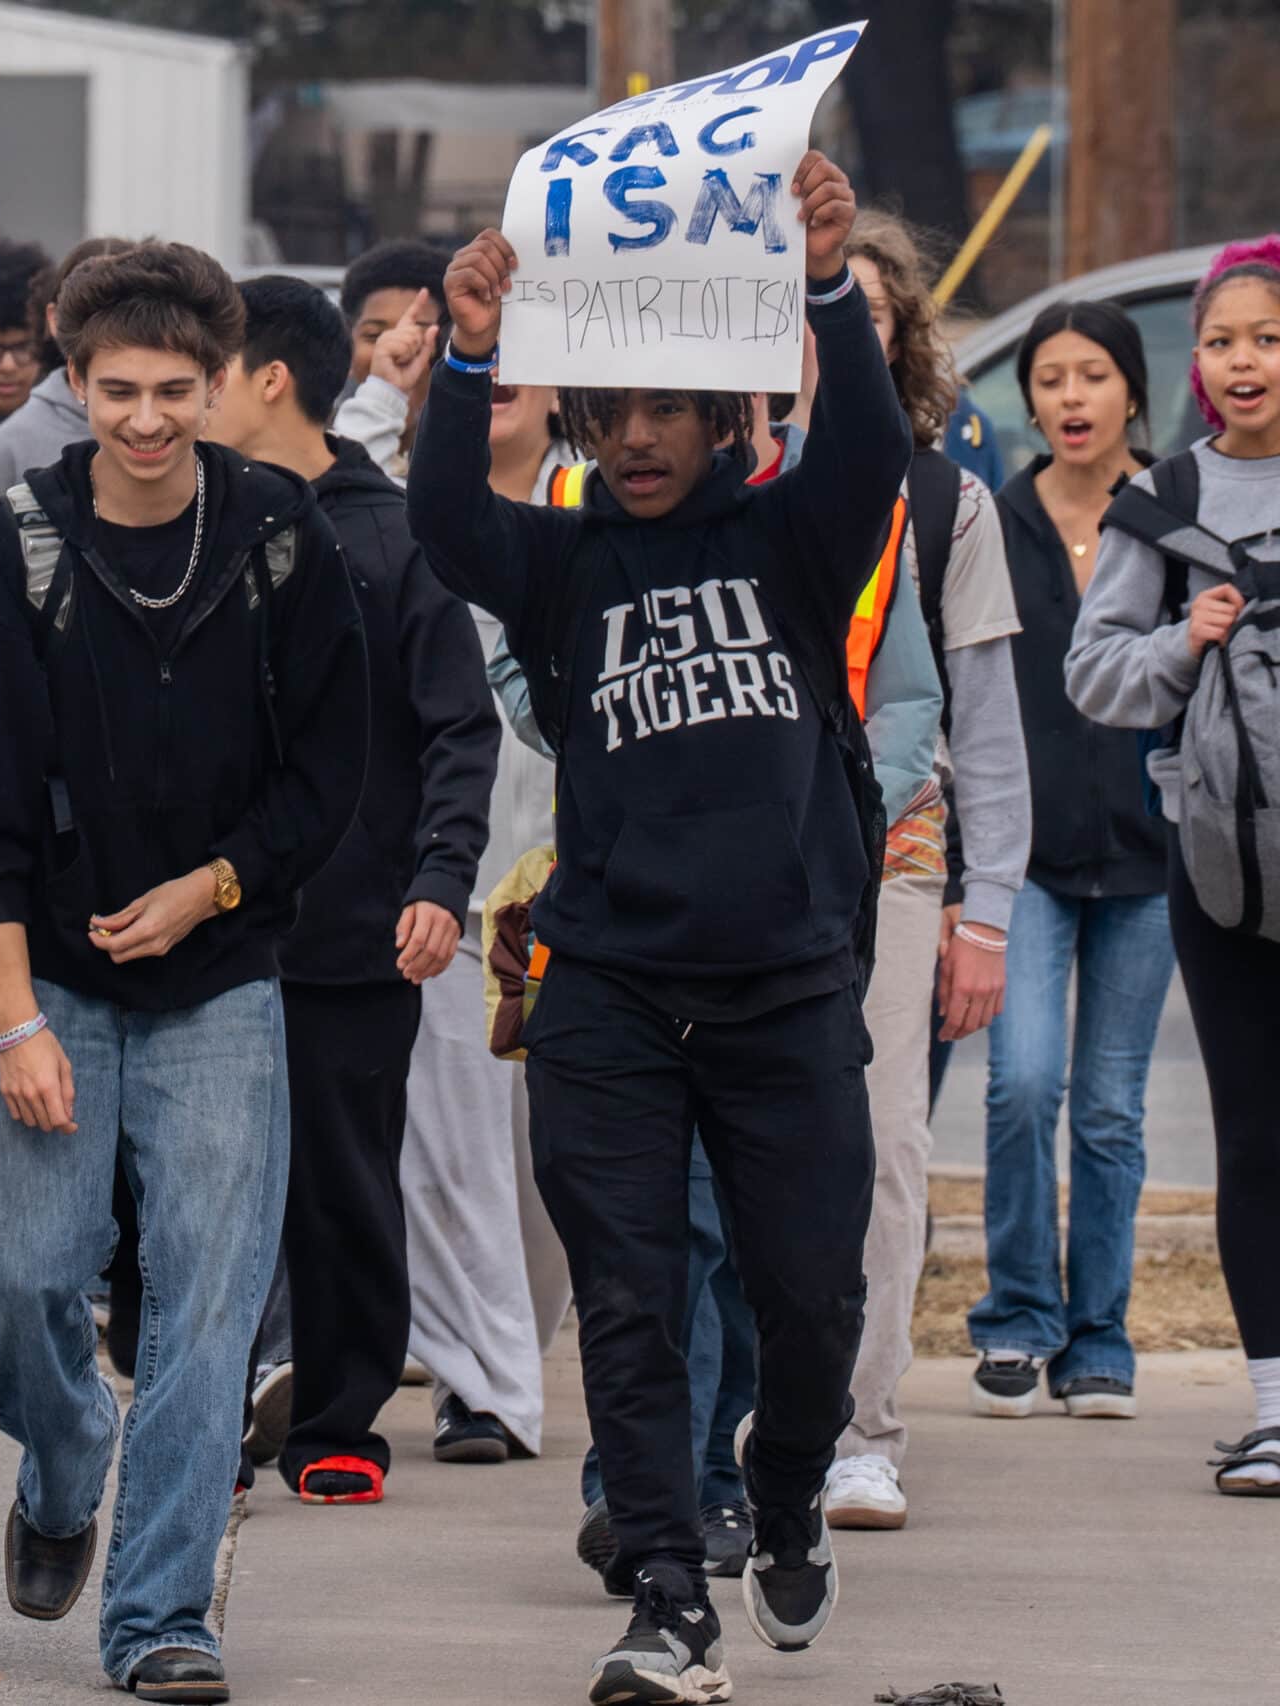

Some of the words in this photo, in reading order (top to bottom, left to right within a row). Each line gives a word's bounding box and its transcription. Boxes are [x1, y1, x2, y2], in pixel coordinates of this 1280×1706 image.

[599, 29, 861, 117] STOP
[544, 166, 788, 256] ISM
[514, 281, 557, 304] IS
[563, 276, 800, 353] PATRIOTISM
[597, 578, 773, 683] LSU
[591, 651, 801, 753] TIGERS
